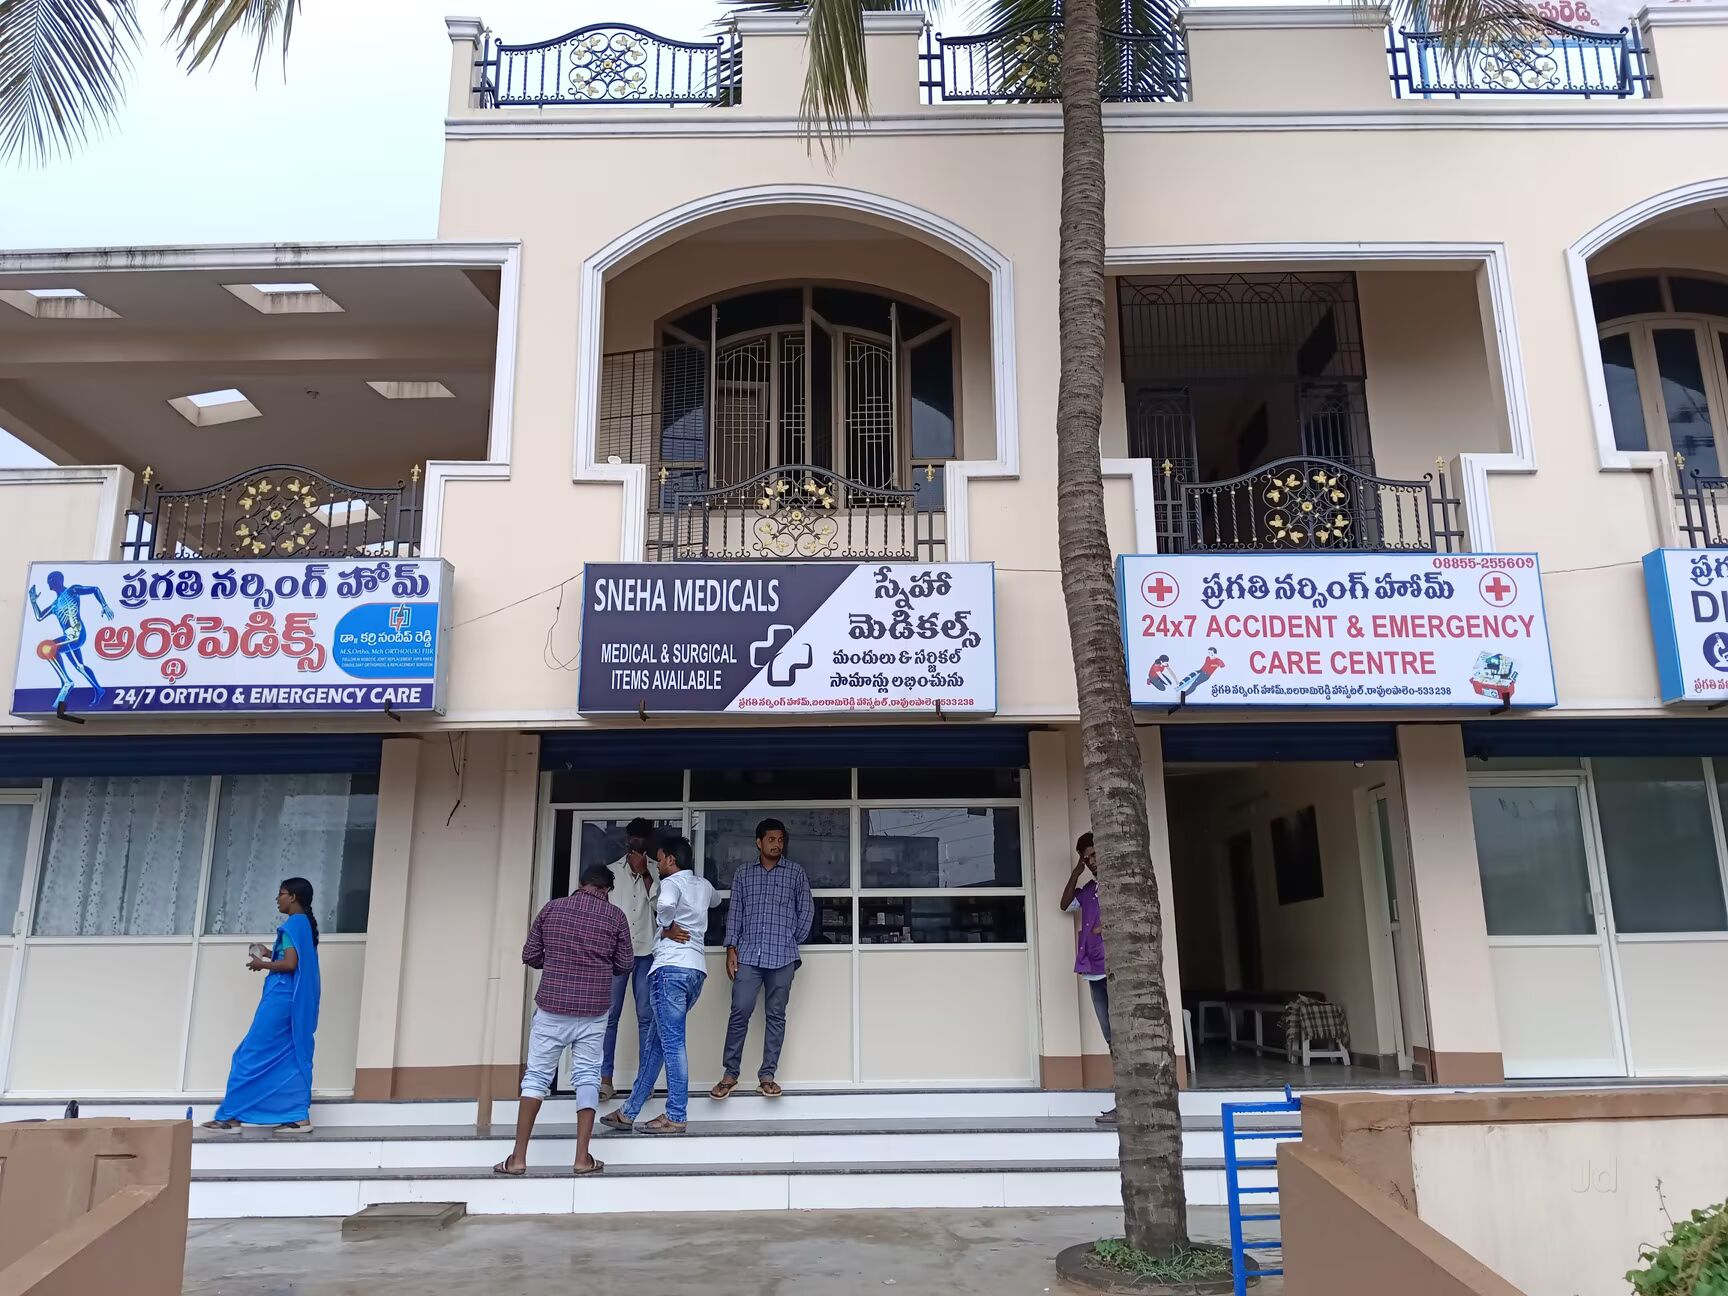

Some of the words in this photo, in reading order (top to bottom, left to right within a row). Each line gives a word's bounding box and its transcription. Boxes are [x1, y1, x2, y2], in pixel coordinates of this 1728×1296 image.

[1432, 556, 1535, 569] 08855-255609
[119, 568, 204, 609] ప్రగతి
[211, 563, 330, 609] నర్సింగ్
[336, 561, 430, 599] హోమ్
[594, 578, 667, 612] SNEHA
[674, 579, 779, 612] MEDICALS
[873, 565, 953, 610] స్నేహా
[1200, 572, 1271, 609] ప్రగతి
[1274, 571, 1370, 609] నర్సింగ్
[1374, 571, 1455, 600] హోమ్
[848, 609, 982, 649] మెడికల్స్
[1142, 614, 1198, 638] 24x7
[1206, 614, 1338, 638] ACCIDENT
[1347, 614, 1366, 638] &
[1373, 614, 1534, 638] EMERGENCY
[601, 643, 658, 664] MEDICAL
[660, 643, 670, 664] &
[673, 643, 737, 664] SURGICAL
[832, 649, 896, 664] మందులు
[898, 650, 913, 664] &
[914, 649, 963, 673] సర్జికల్
[1249, 651, 1323, 674] CARE
[1331, 651, 1437, 674] CENTRE
[611, 670, 650, 690] ITEMS
[652, 670, 722, 690] AVAILABLE
[113, 688, 156, 707] 24/7
[159, 687, 228, 704] ORTHO
[231, 687, 245, 704] &
[249, 687, 367, 705] EMERGENCY
[370, 687, 421, 704] CARE
